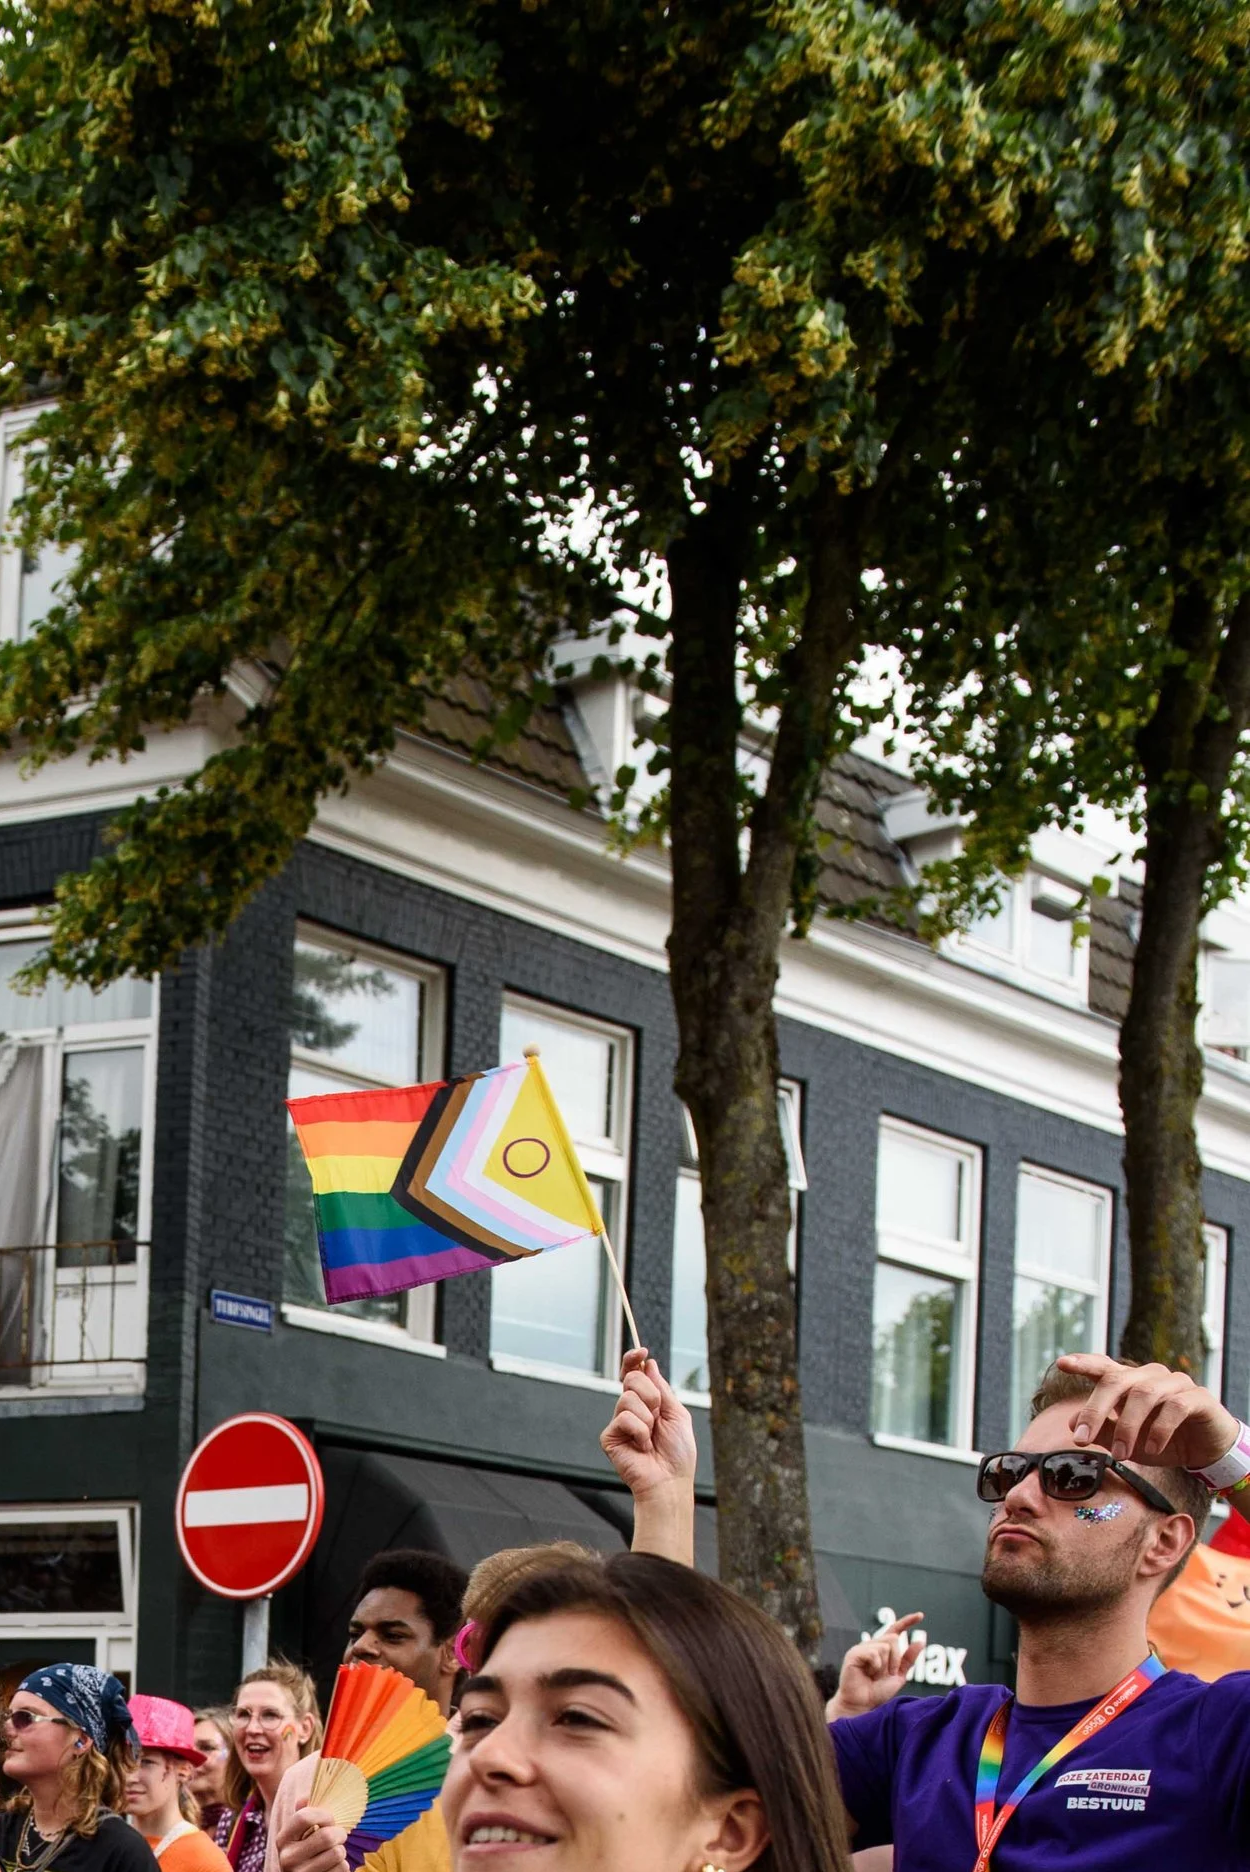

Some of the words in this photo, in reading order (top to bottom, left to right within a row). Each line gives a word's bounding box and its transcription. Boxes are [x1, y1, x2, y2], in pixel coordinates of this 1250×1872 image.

[1085, 1772, 1146, 1782] ZATERDAG
[1090, 1781, 1148, 1795] GRONINGEN
[1066, 1797, 1146, 1812] BESTUUR
